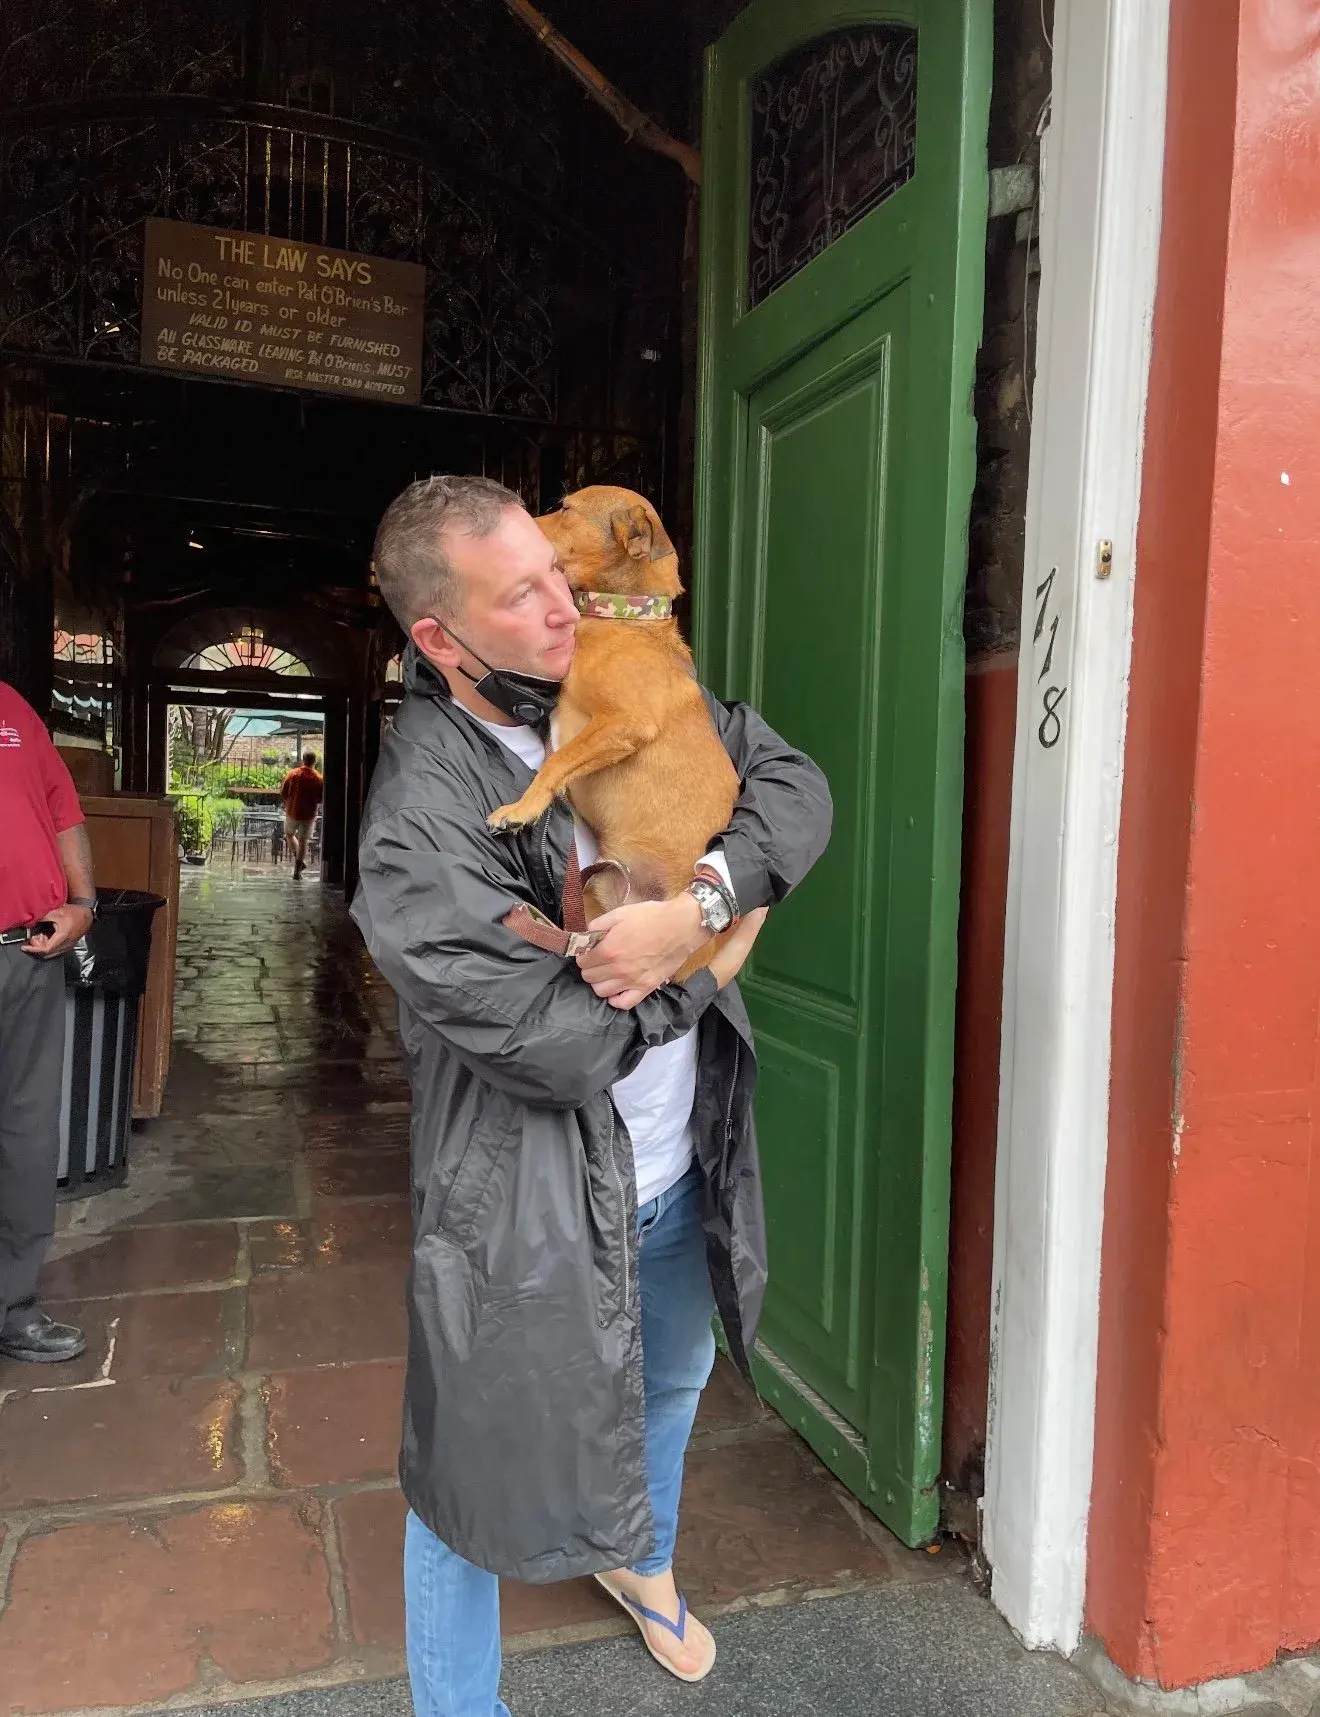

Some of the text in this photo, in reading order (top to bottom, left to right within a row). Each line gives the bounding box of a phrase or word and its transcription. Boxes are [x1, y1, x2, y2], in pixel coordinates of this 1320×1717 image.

[215, 235, 372, 285] THE LAW SAYS
[158, 258, 183, 280] No
[188, 262, 218, 286] One
[224, 275, 249, 290] can
[256, 277, 294, 297] enter
[297, 280, 320, 302] Pat
[382, 295, 408, 317] Bar
[158, 283, 208, 307] unless
[279, 306, 300, 320] or
[306, 306, 347, 328] older
[157, 345, 179, 362] BE
[182, 332, 254, 356] GLASSWARE
[258, 342, 305, 363] LEAVING
[376, 362, 413, 380] MUST
[189, 313, 400, 358] VALID ID MUST BE FURNISHED
